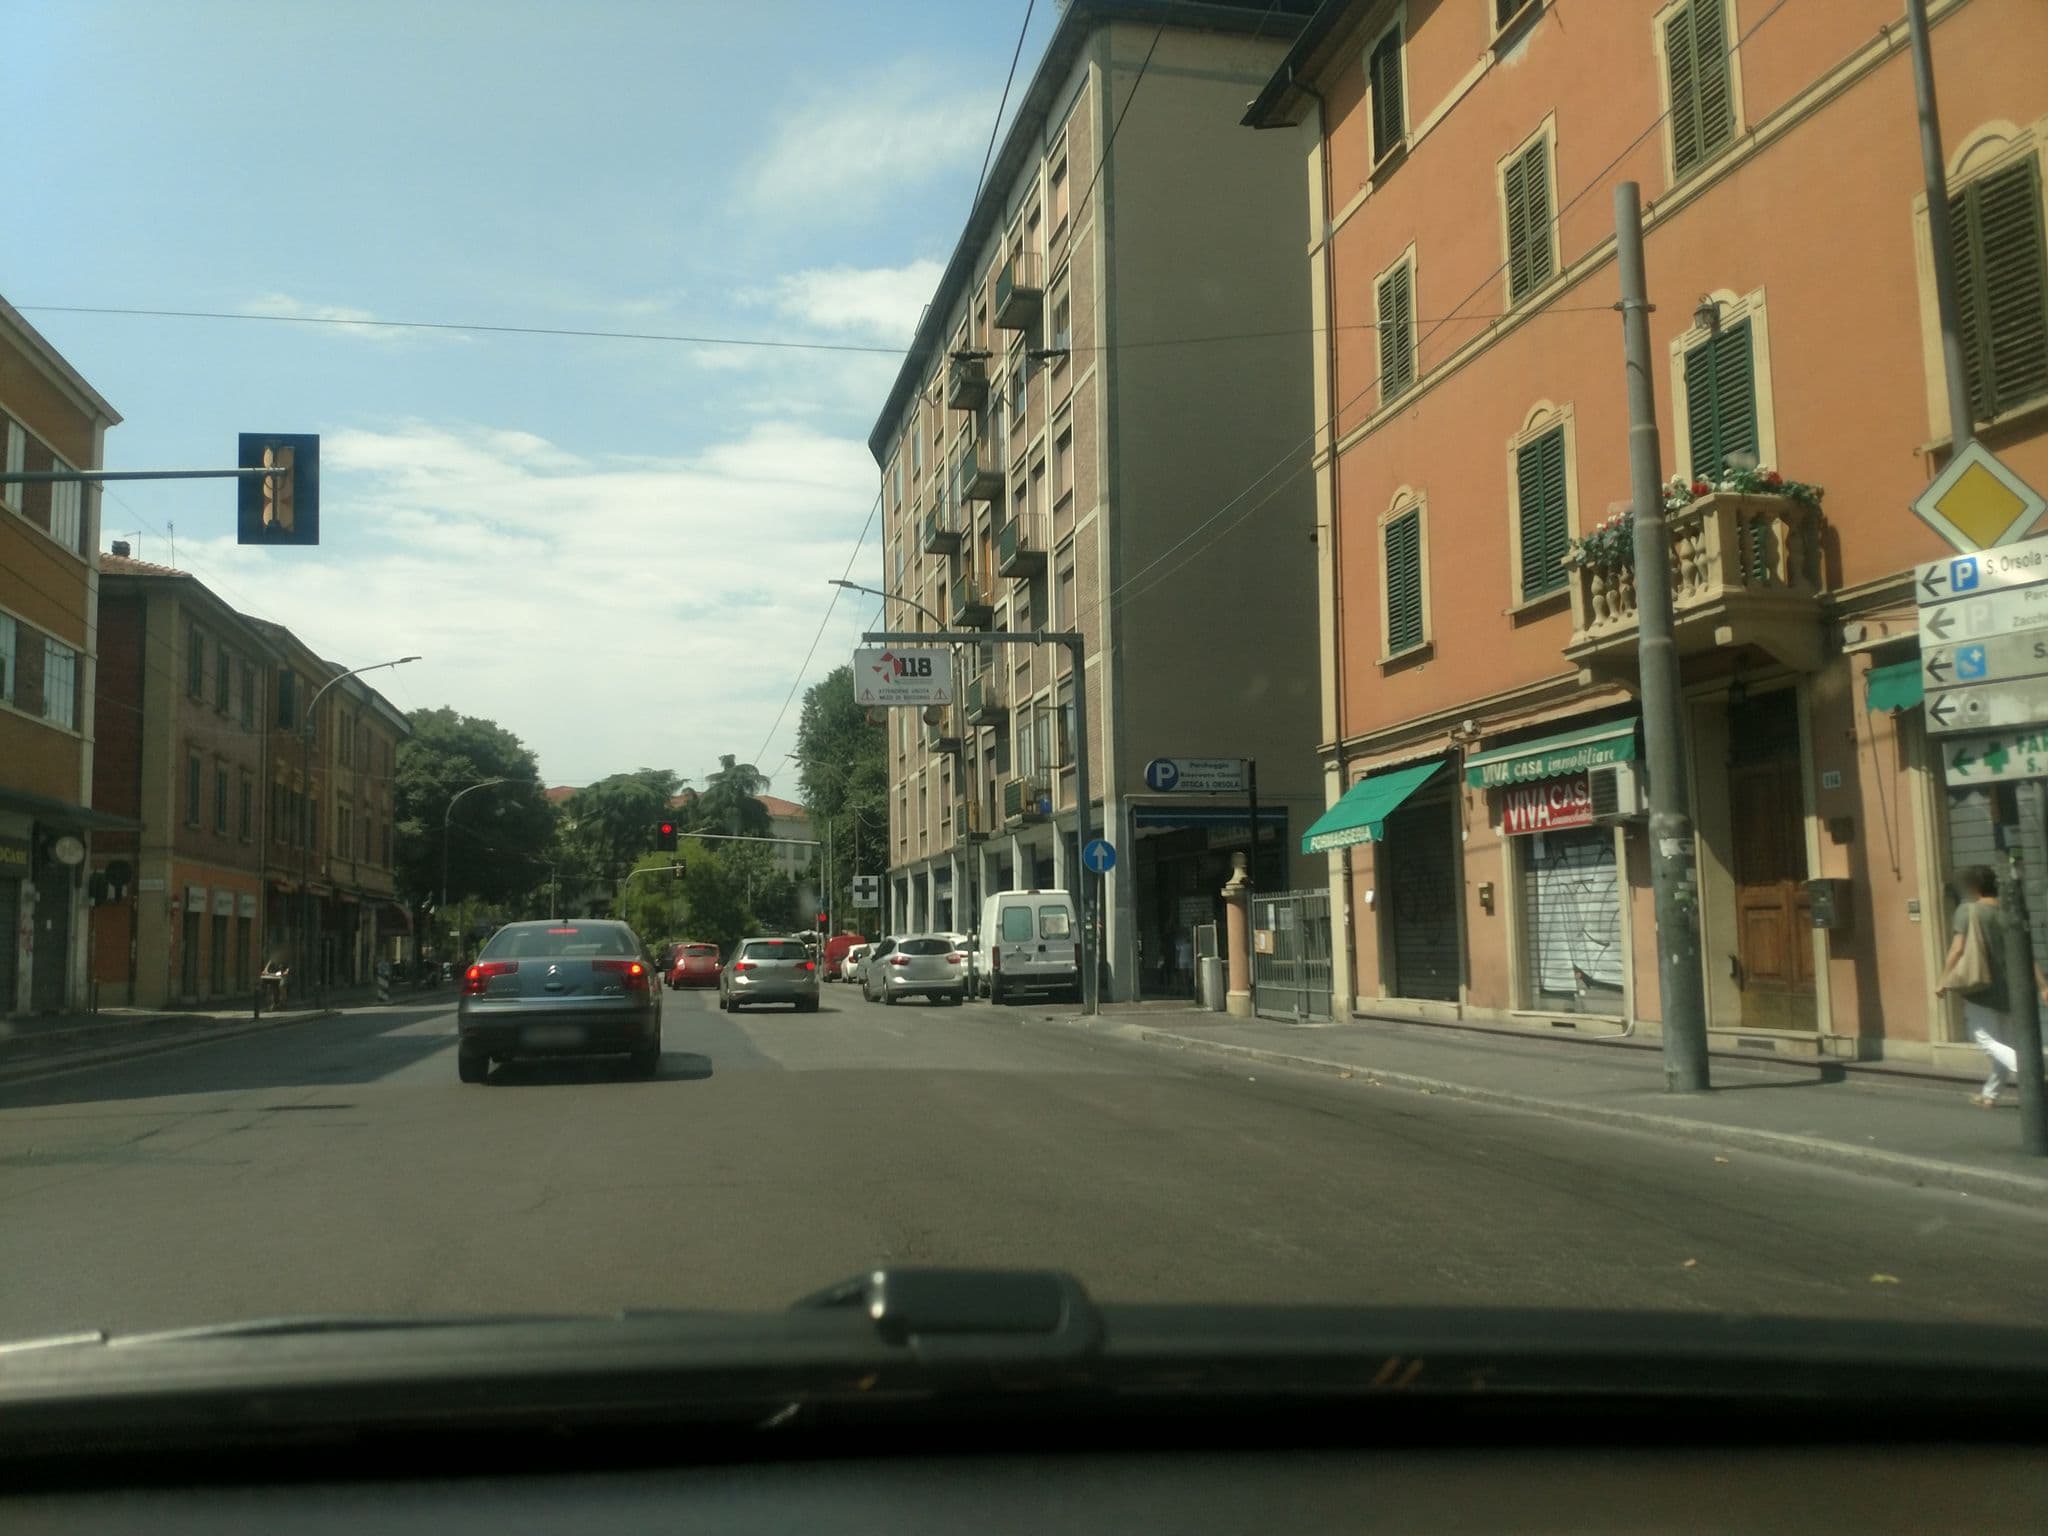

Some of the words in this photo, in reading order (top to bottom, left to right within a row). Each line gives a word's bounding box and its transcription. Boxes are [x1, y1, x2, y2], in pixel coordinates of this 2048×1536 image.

[1957, 562, 1972, 588] P
[1986, 559, 1998, 575] S.
[2000, 551, 2042, 572] Orsola
[899, 657, 932, 677] 118
[1155, 762, 1175, 787] P
[1482, 762, 1509, 783] VIVA
[1548, 748, 1614, 771] immobiliare
[1212, 780, 1240, 788] ORSOLA
[1550, 780, 1592, 810] CAS
[1507, 787, 1551, 831] VIVA
